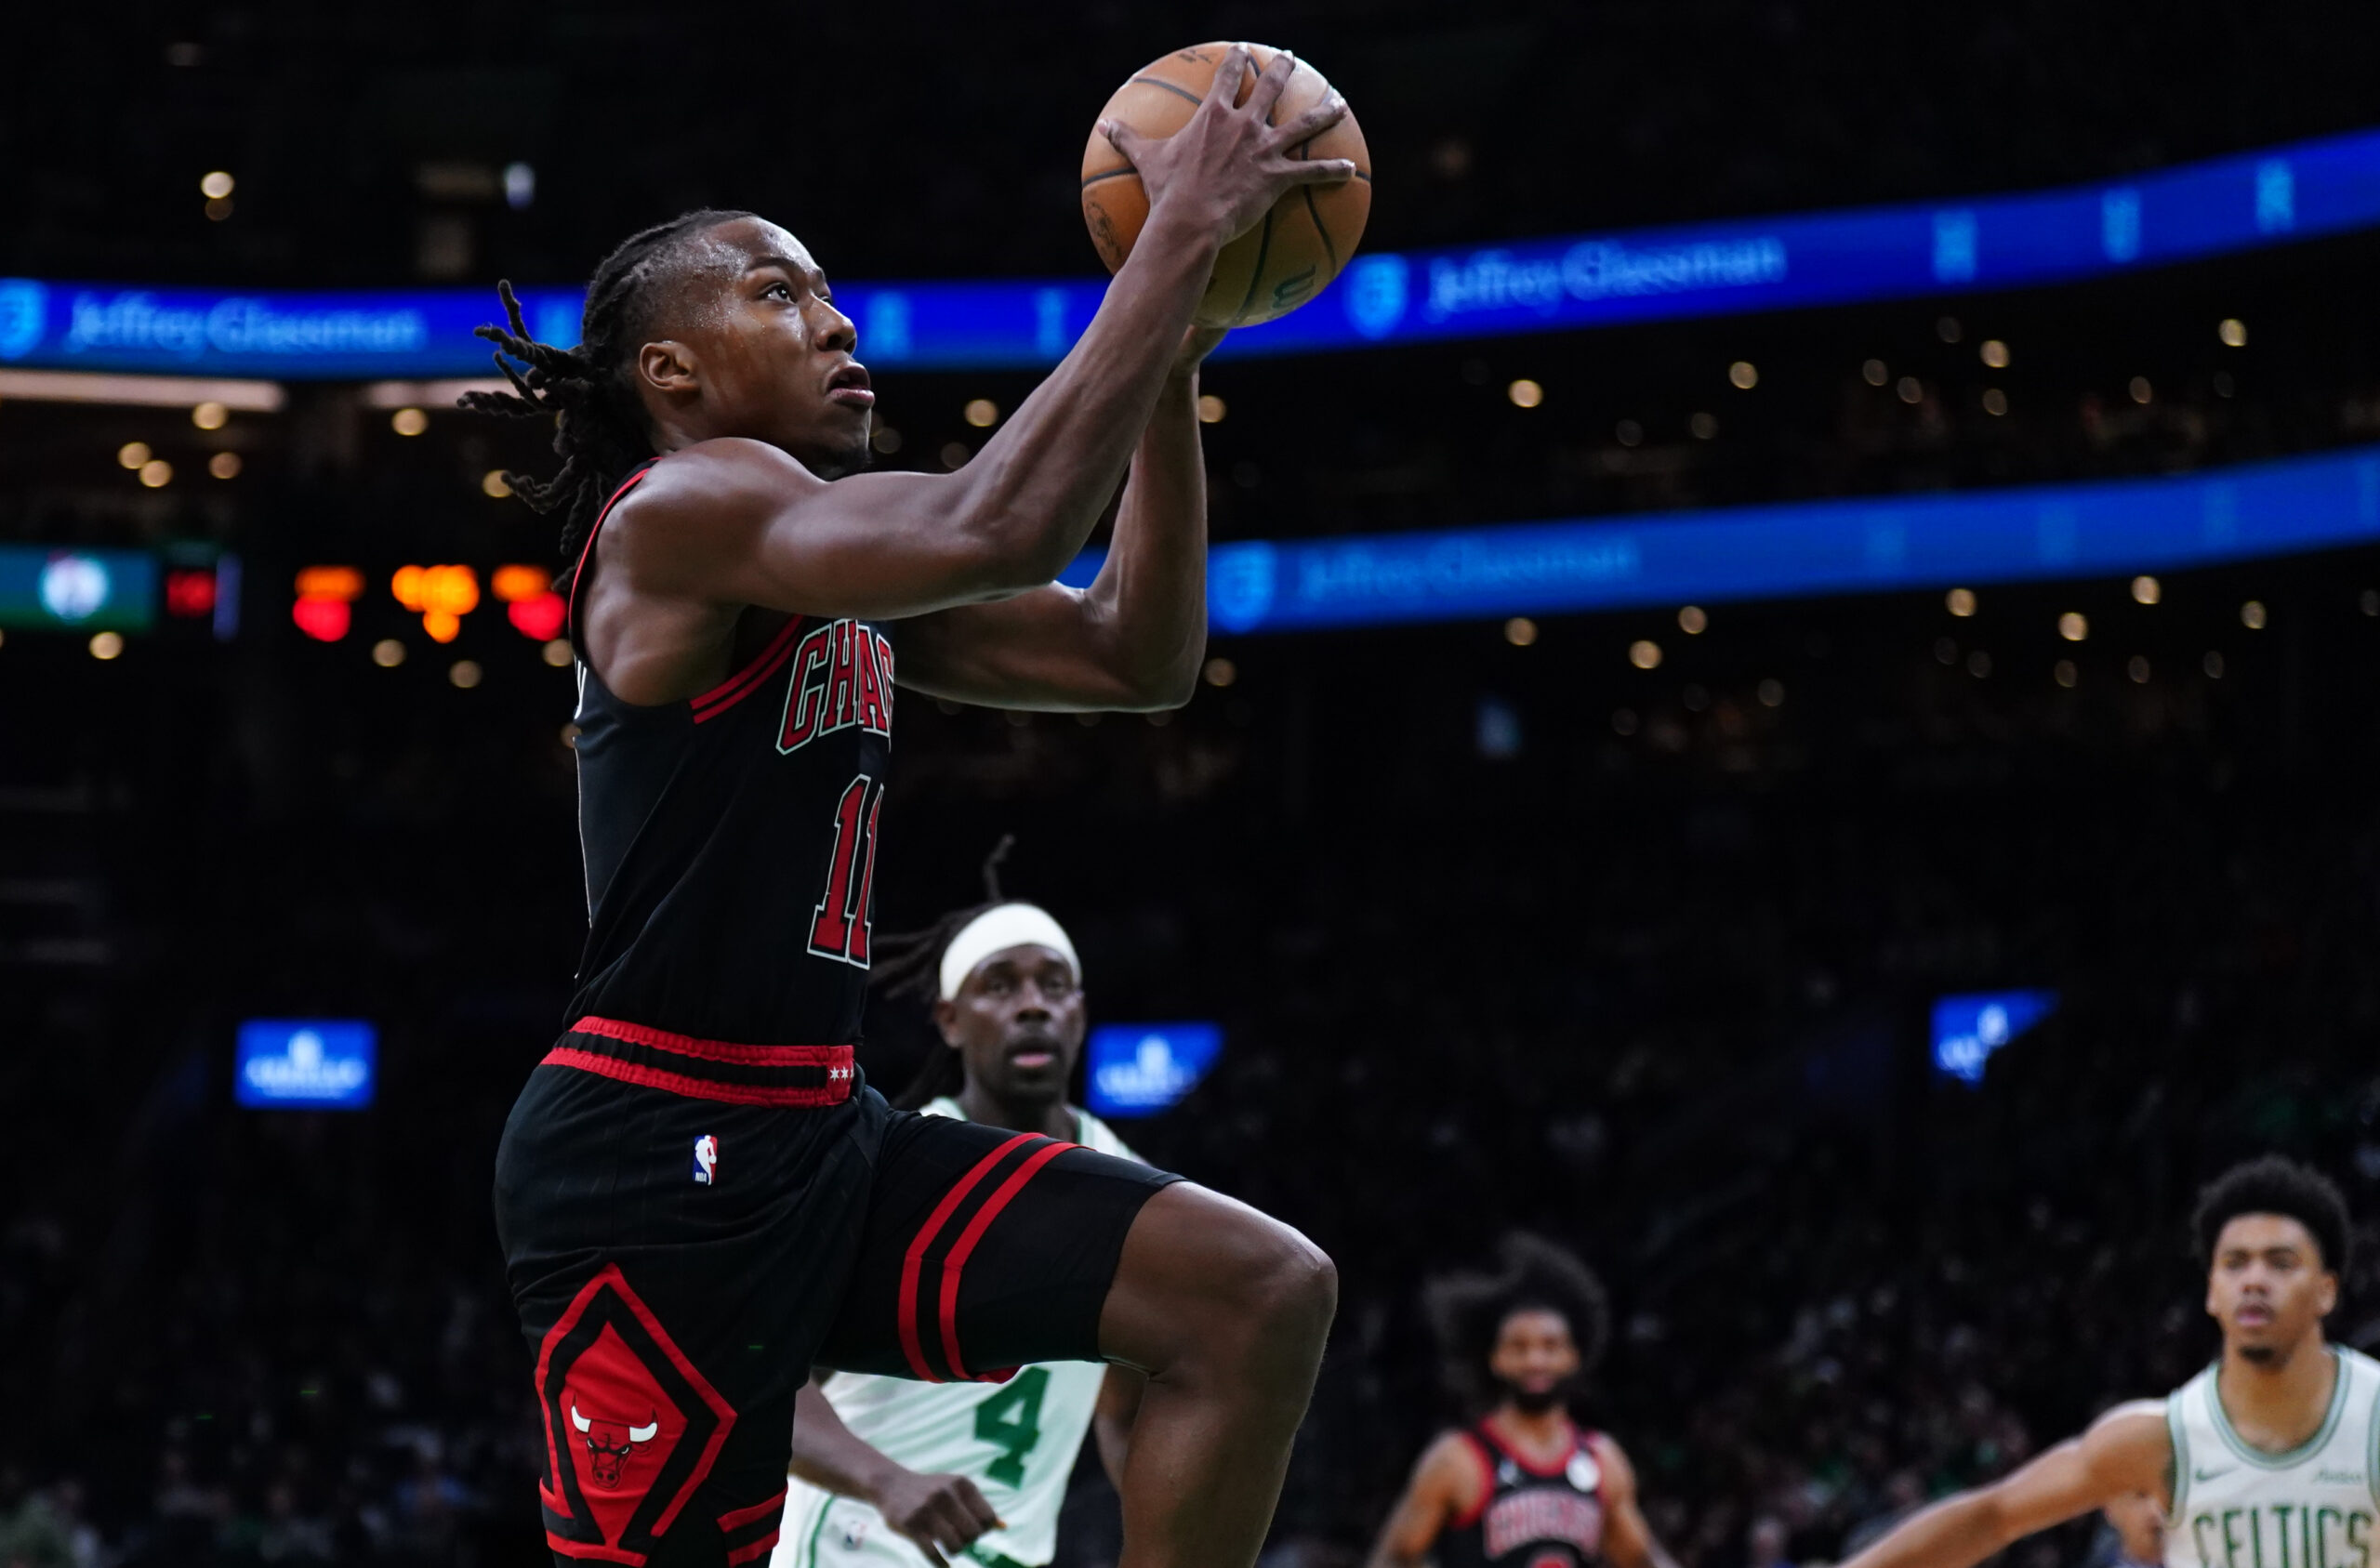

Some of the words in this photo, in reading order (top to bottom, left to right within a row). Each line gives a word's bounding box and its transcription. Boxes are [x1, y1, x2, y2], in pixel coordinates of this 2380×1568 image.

[65, 290, 206, 361] Jeffrey
[807, 773, 884, 970] 11
[695, 1172, 707, 1182] NBA
[974, 1366, 1051, 1491] 4
